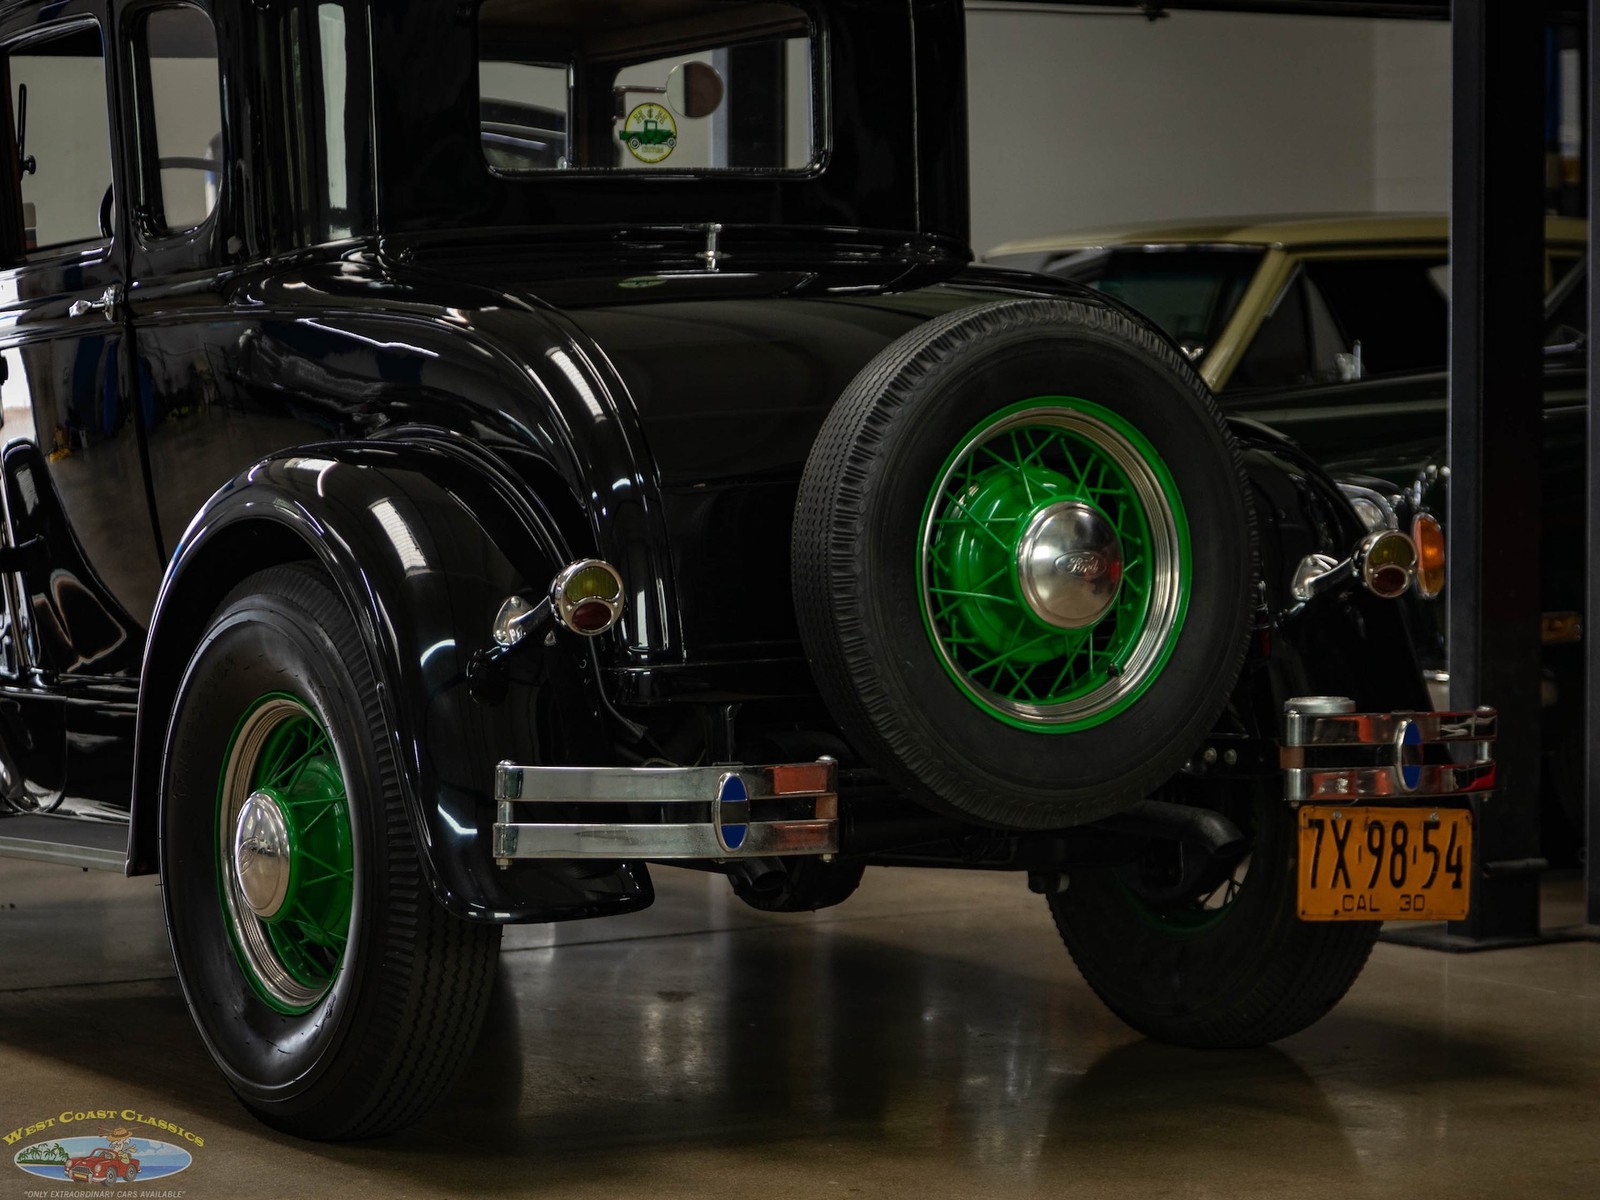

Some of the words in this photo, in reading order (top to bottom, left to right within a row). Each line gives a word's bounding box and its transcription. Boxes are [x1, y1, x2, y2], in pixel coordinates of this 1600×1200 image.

[1065, 554, 1100, 575] Ford
[1342, 894, 1380, 912] CAL
[1400, 894, 1425, 912] 30
